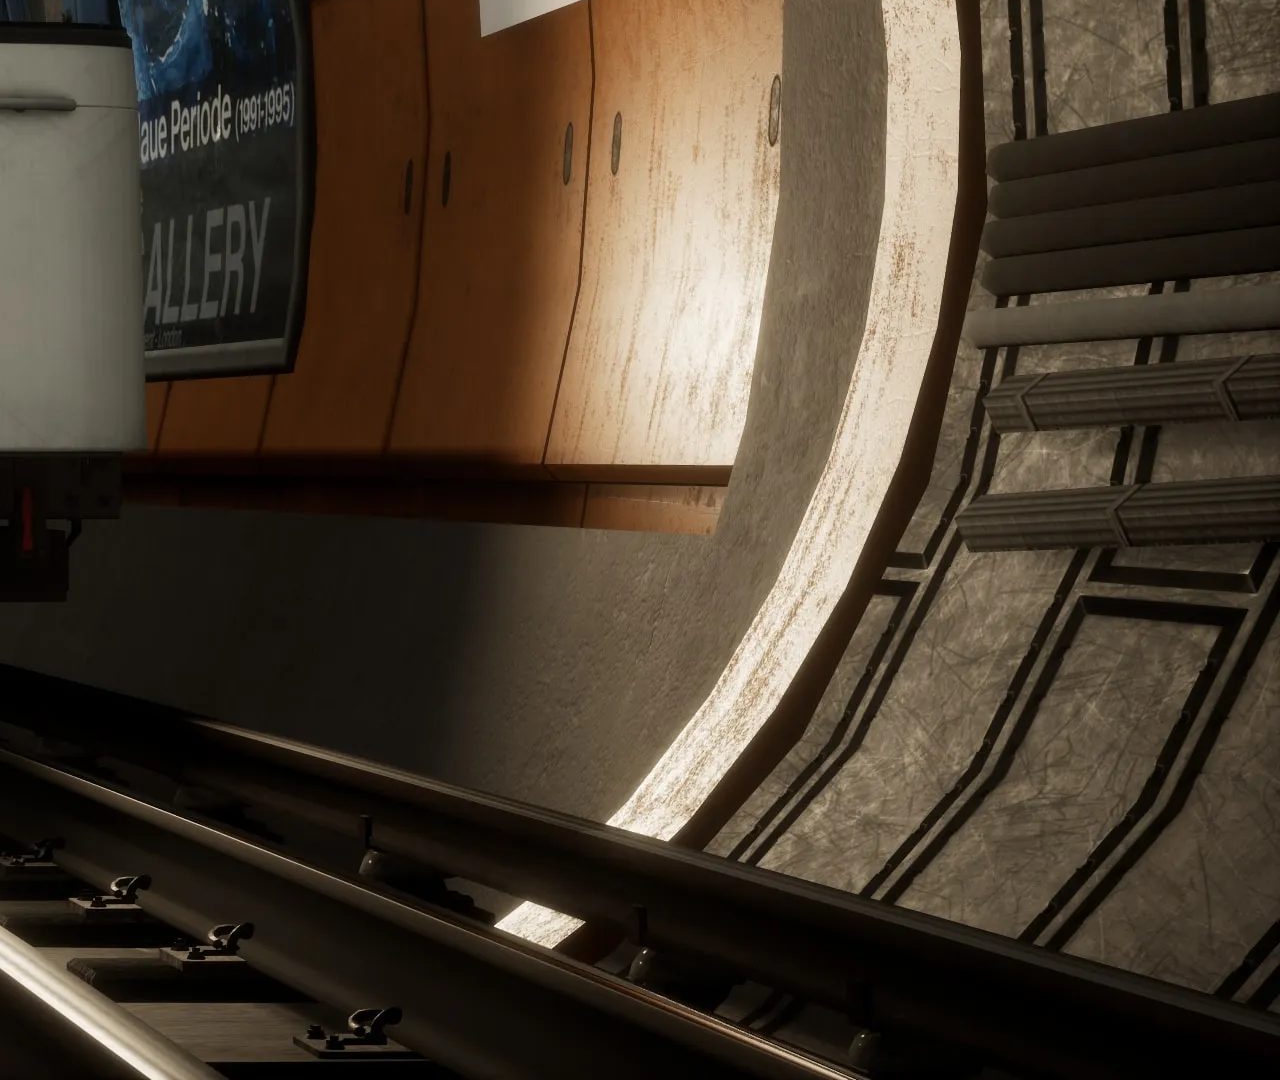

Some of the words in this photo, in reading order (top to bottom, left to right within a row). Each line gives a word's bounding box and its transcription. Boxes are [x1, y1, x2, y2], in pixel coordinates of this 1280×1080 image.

[171, 83, 232, 156] Periode
[235, 81, 296, 143] (1991-1995)
[141, 198, 271, 324] ALLERY
